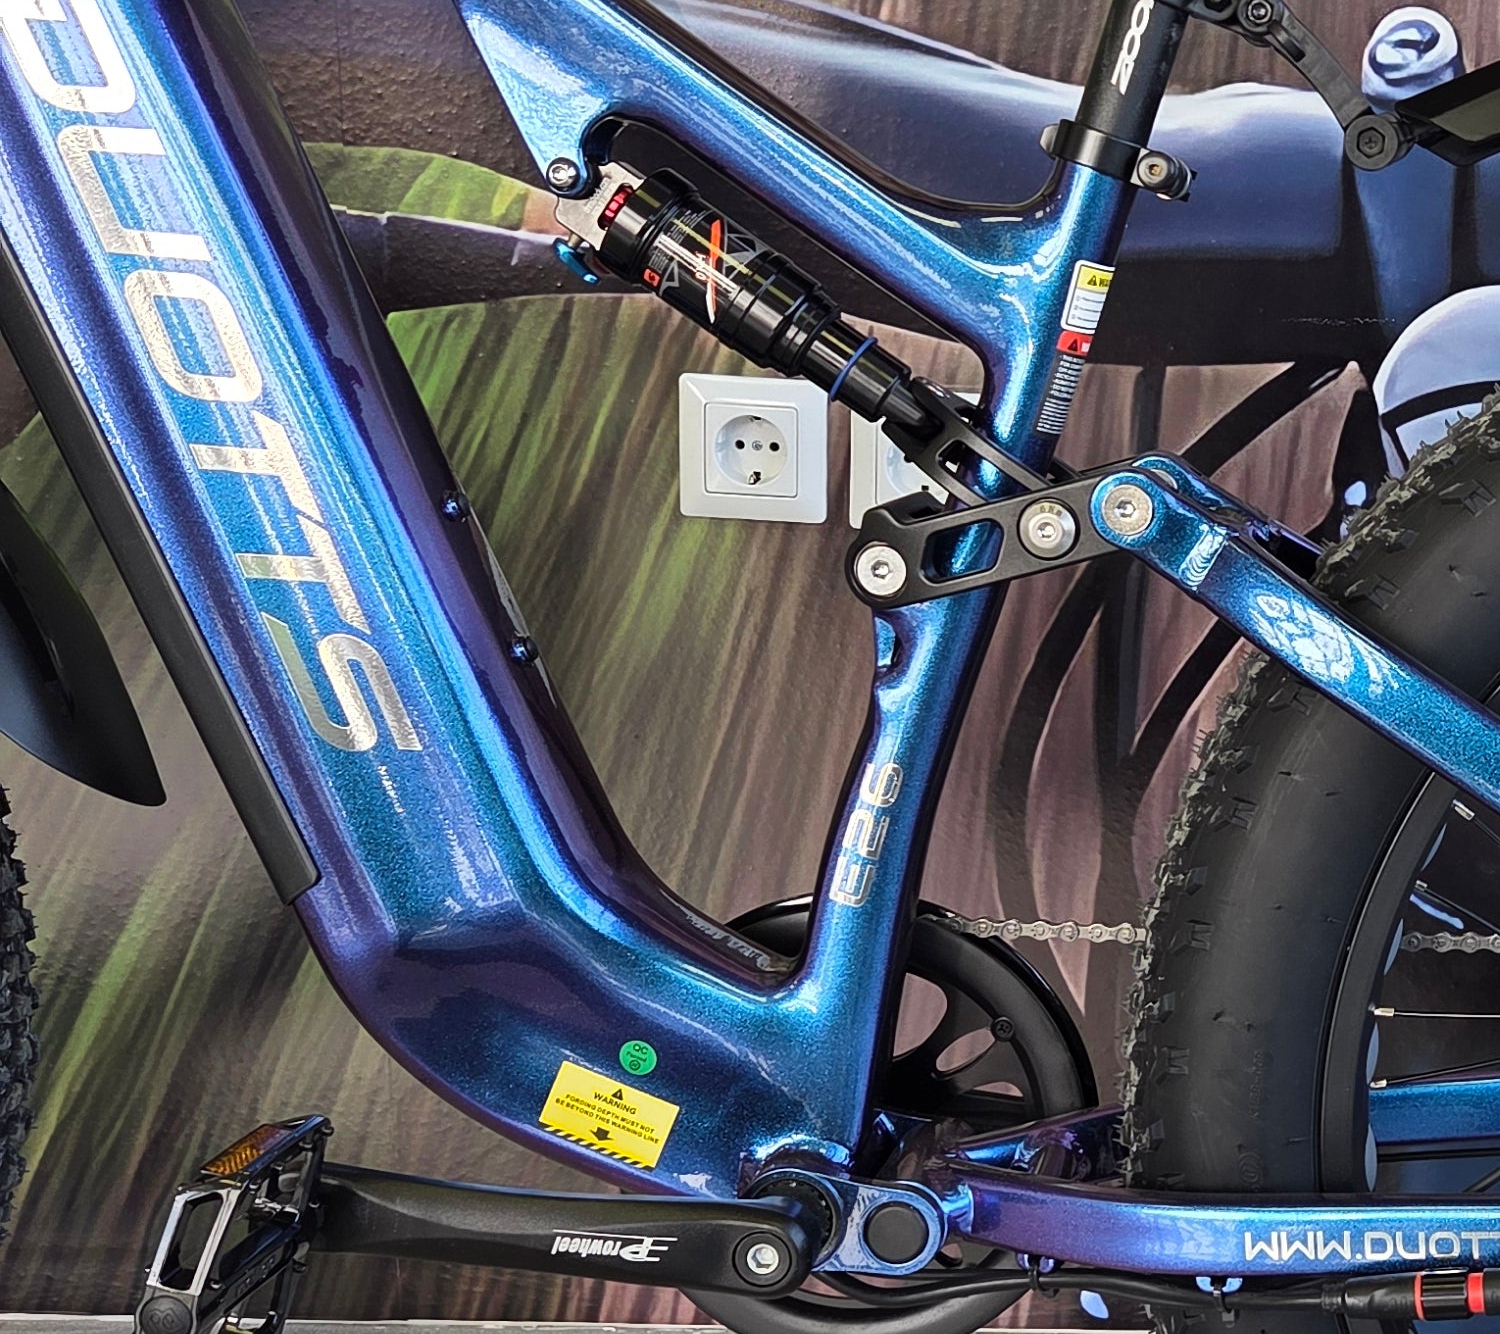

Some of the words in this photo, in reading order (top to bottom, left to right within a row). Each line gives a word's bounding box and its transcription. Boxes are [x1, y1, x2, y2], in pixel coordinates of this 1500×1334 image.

[830, 762, 903, 907] E26
[632, 1043, 649, 1056] QC
[565, 1093, 596, 1111] FORDING
[597, 1106, 620, 1120] DEPTH
[620, 1115, 640, 1128] MUST
[640, 1125, 655, 1135] NOT
[594, 1091, 637, 1115] WARNING
[555, 1097, 565, 1106] BE
[565, 1102, 594, 1118] BEYOND
[595, 1114, 610, 1125] THIS
[611, 1121, 643, 1138] WARNING
[643, 1134, 659, 1145] LINE
[551, 1233, 674, 1262] Prowheel
